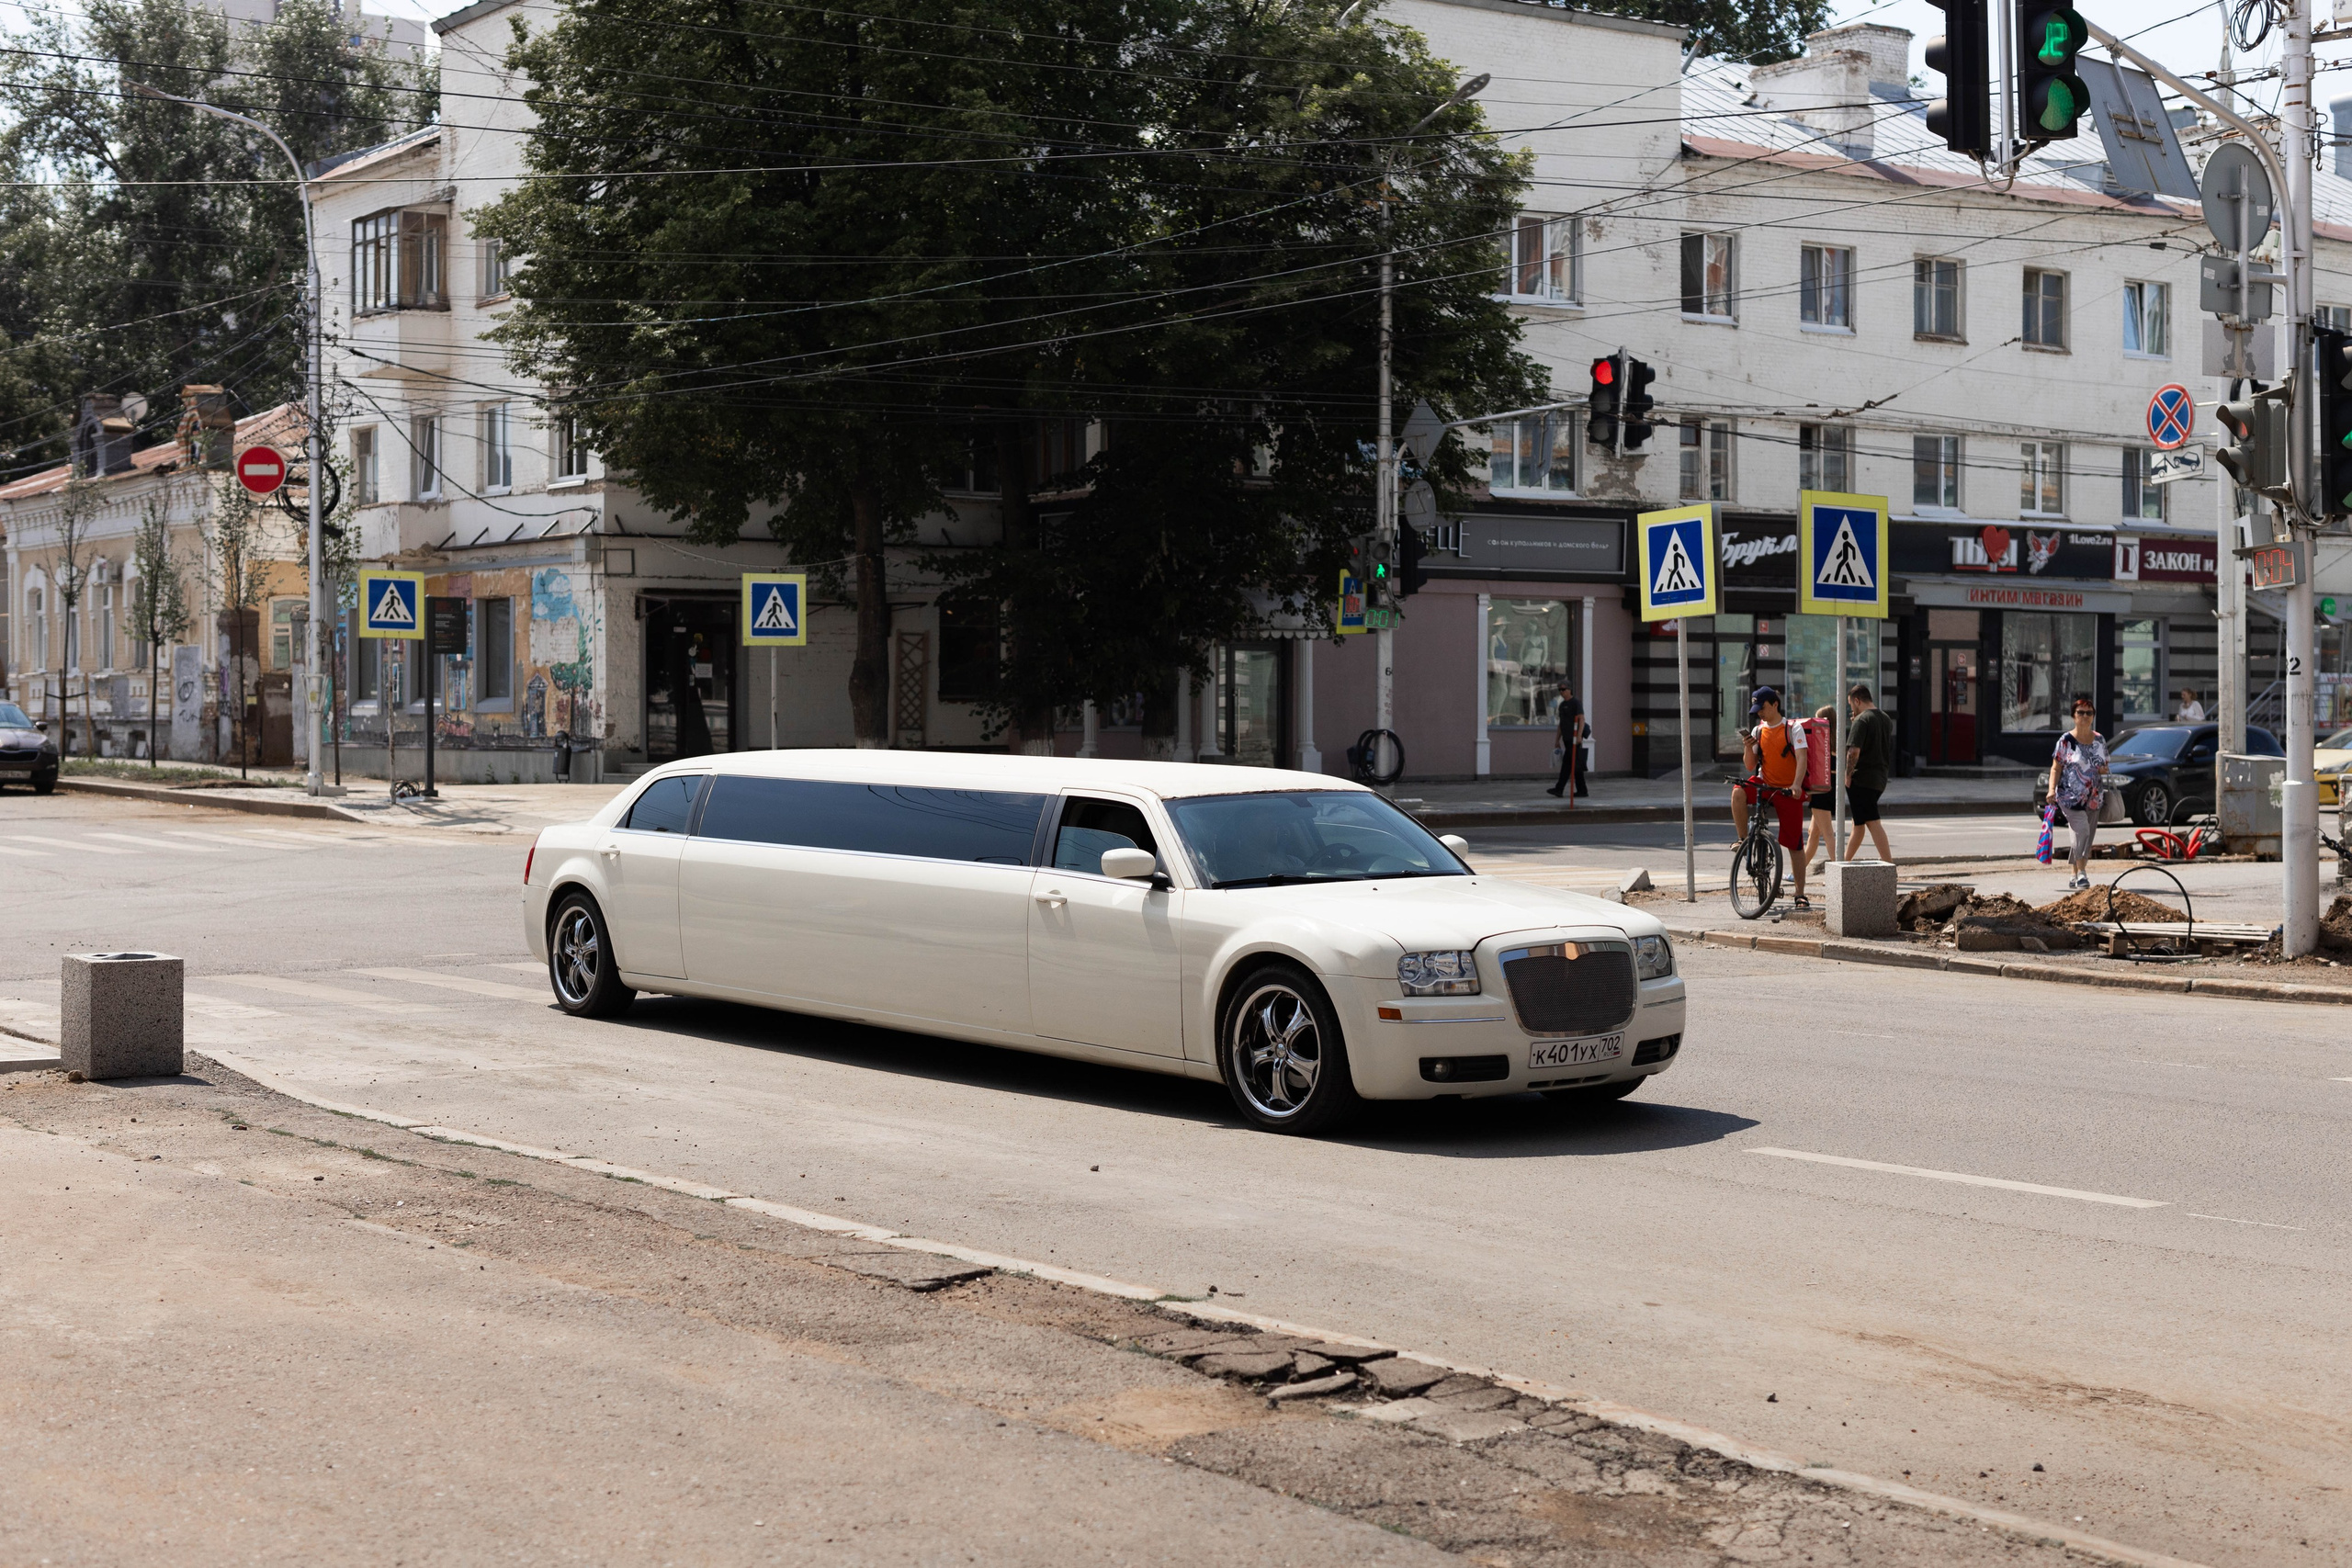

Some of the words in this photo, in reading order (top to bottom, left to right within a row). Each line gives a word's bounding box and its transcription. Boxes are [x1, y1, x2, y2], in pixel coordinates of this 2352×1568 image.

[2068, 533, 2113, 546] 1Love2.ru
[2144, 550, 2201, 571] ЗАКОН
[2256, 548, 2294, 586] 0:04
[1365, 609, 1399, 627] 0:01
[1601, 1035, 1621, 1053] 702
